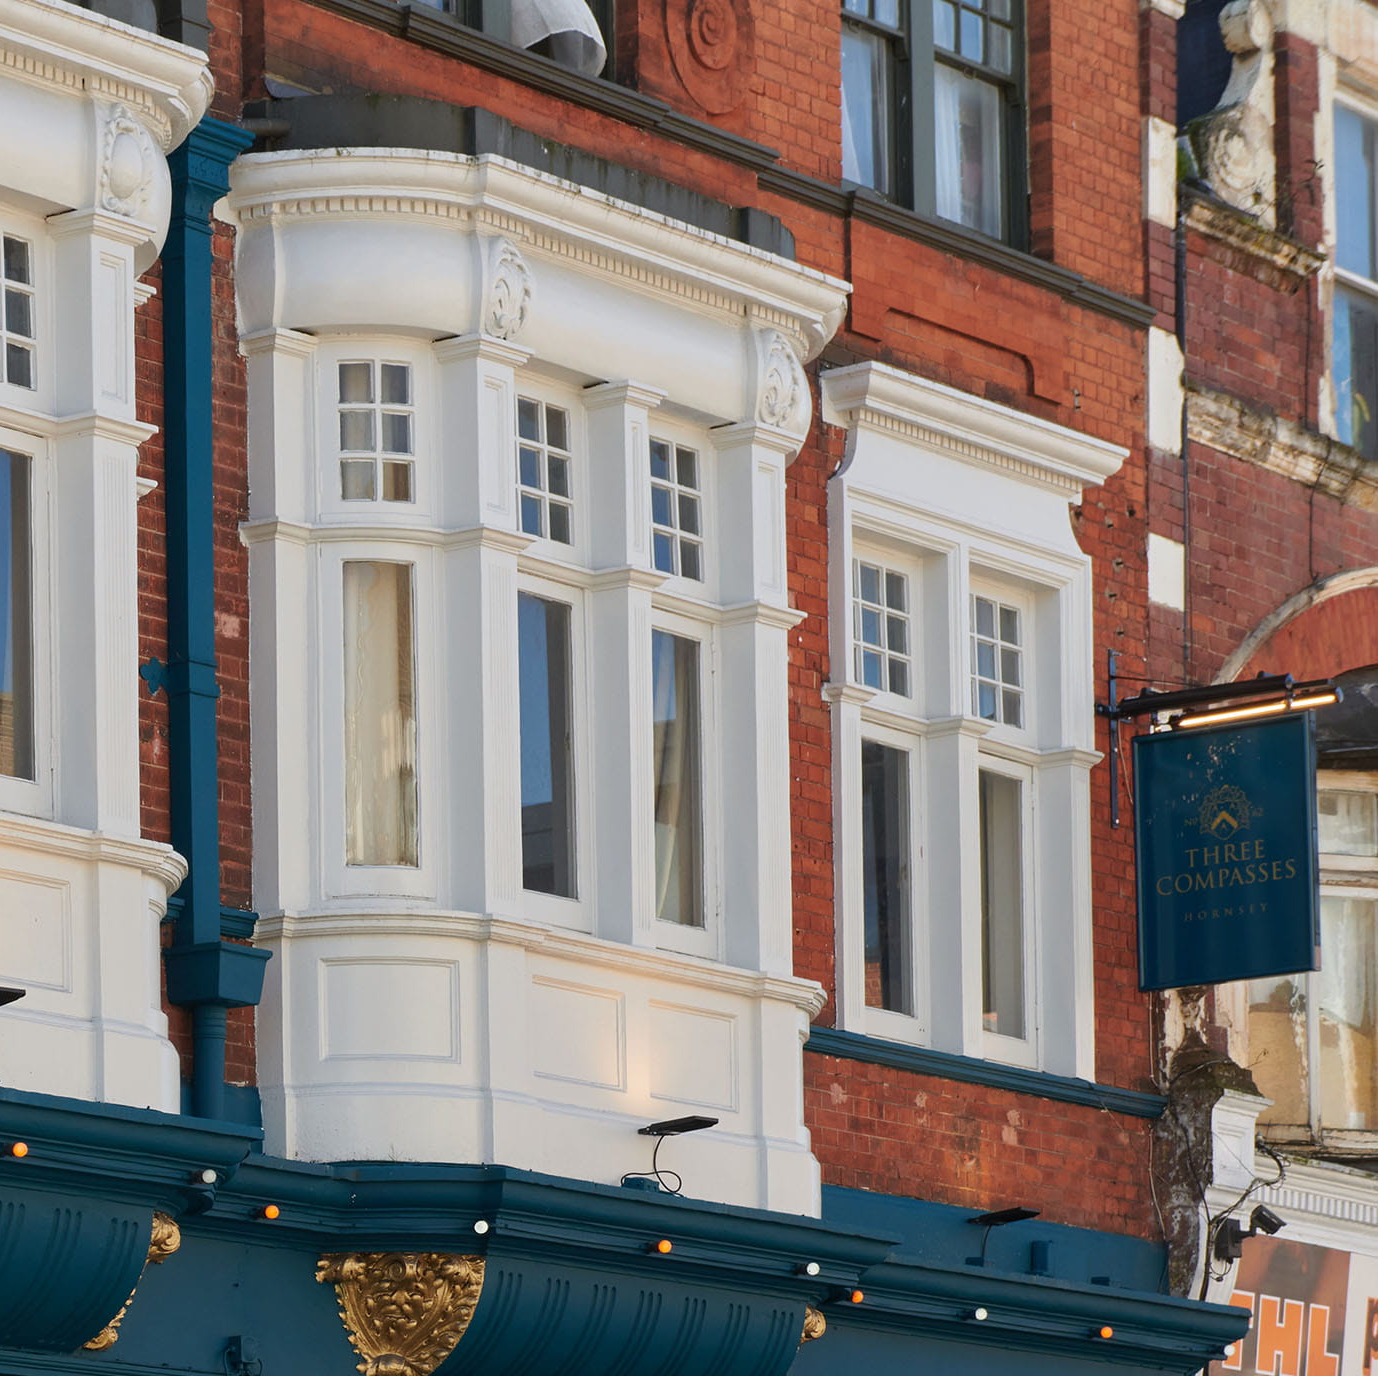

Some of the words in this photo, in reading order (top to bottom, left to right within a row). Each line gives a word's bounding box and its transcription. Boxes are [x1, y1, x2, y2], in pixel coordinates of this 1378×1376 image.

[1184, 839, 1266, 868] THREE
[1155, 858, 1296, 896] COMPASSES
[1184, 902, 1268, 922] HORNSEY
